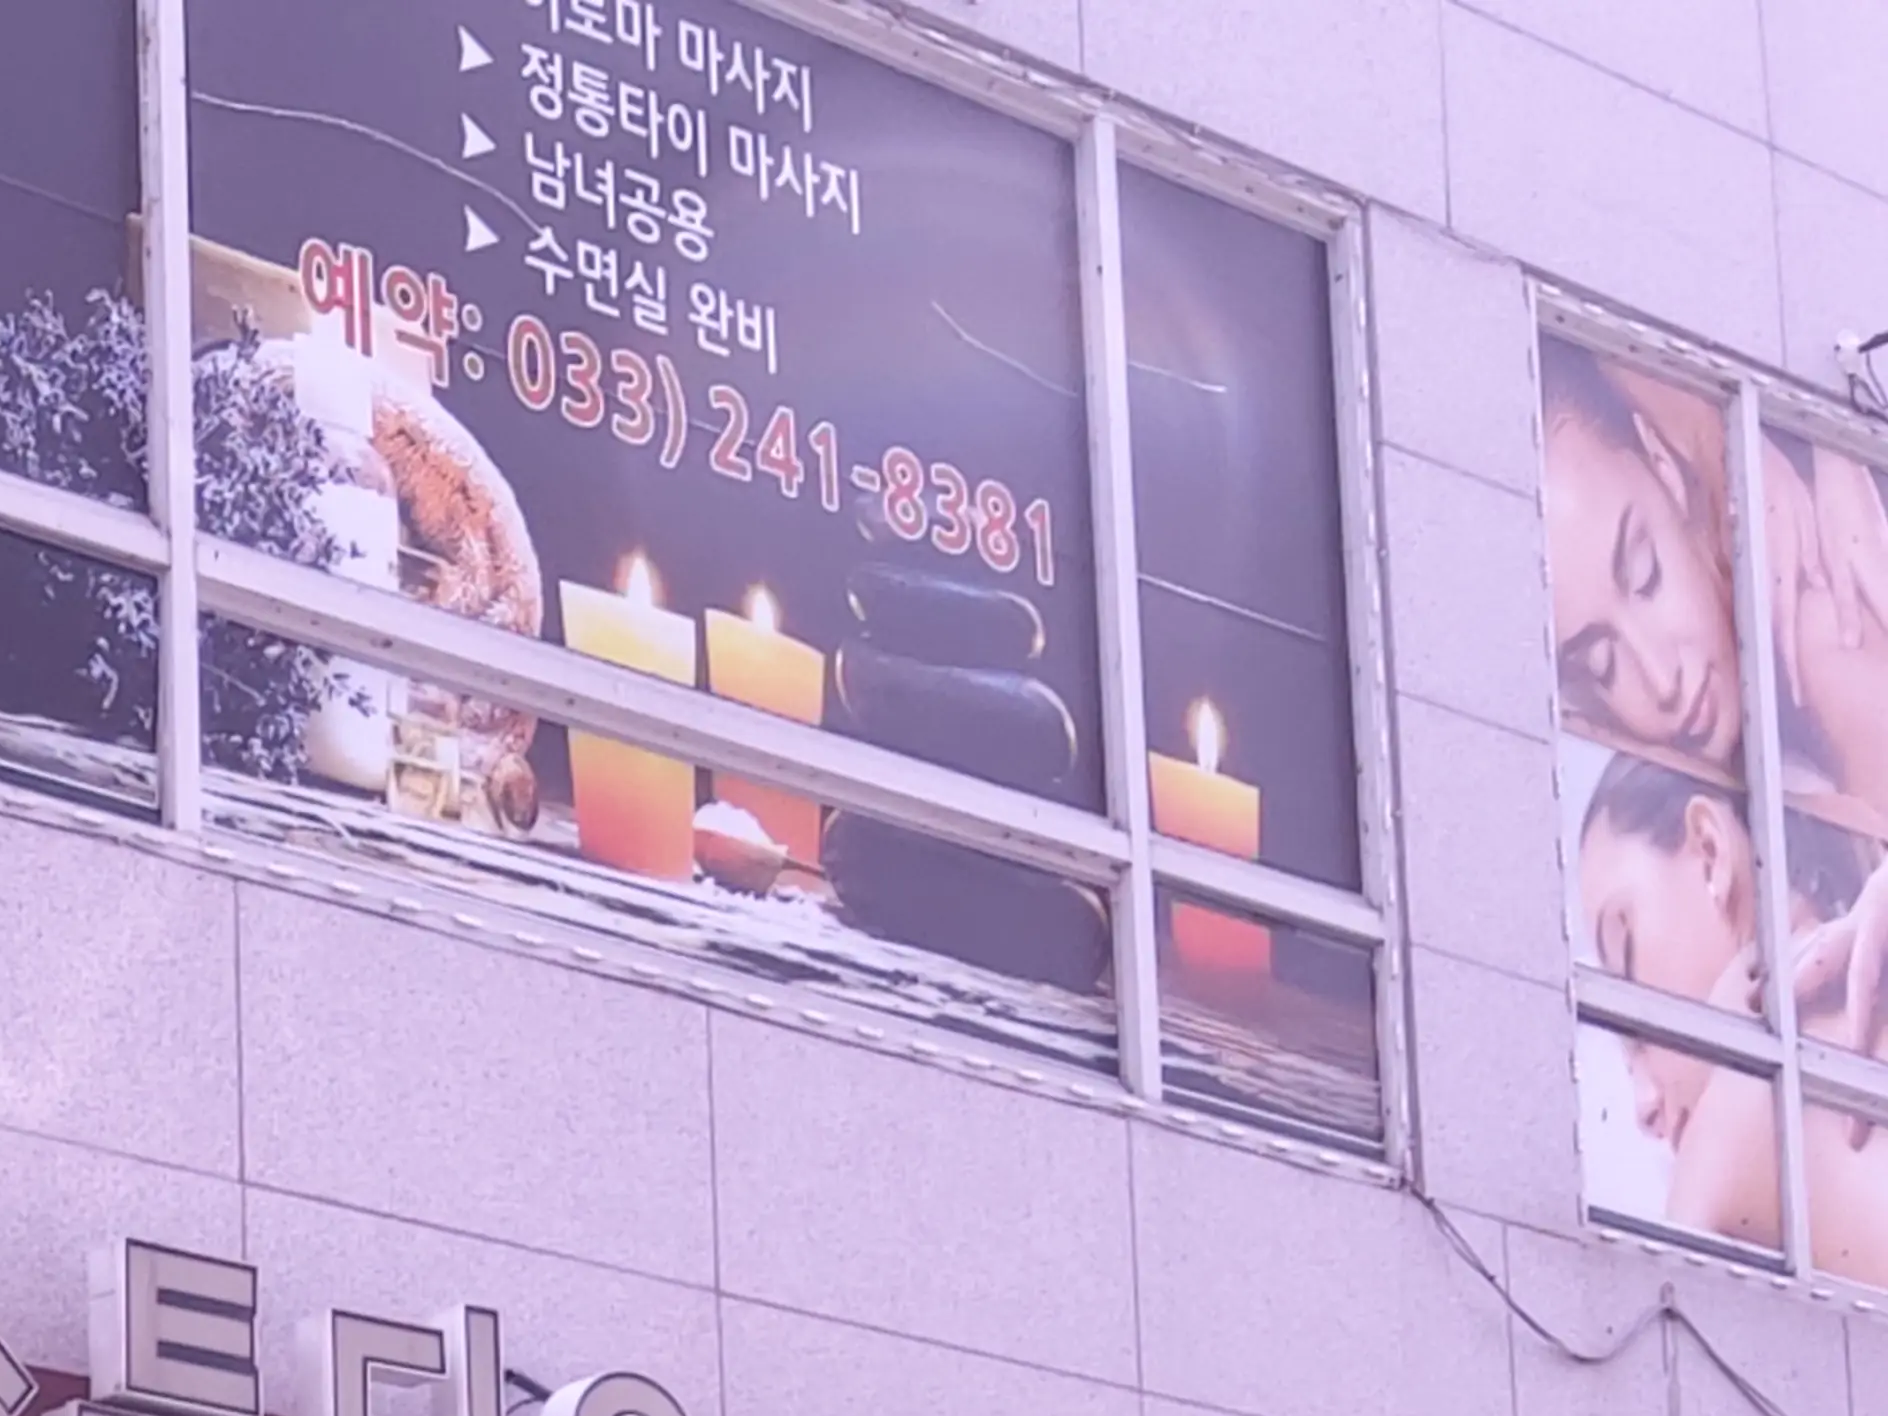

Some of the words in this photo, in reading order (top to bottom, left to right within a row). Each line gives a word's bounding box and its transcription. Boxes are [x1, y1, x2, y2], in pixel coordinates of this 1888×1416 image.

[521, 43, 707, 178] 정통타이
[729, 126, 860, 235] 마사지
[678, 20, 812, 133] 마사지
[524, 132, 715, 262] 남녀공용
[524, 226, 670, 336] 수면실
[688, 283, 777, 375] 완비
